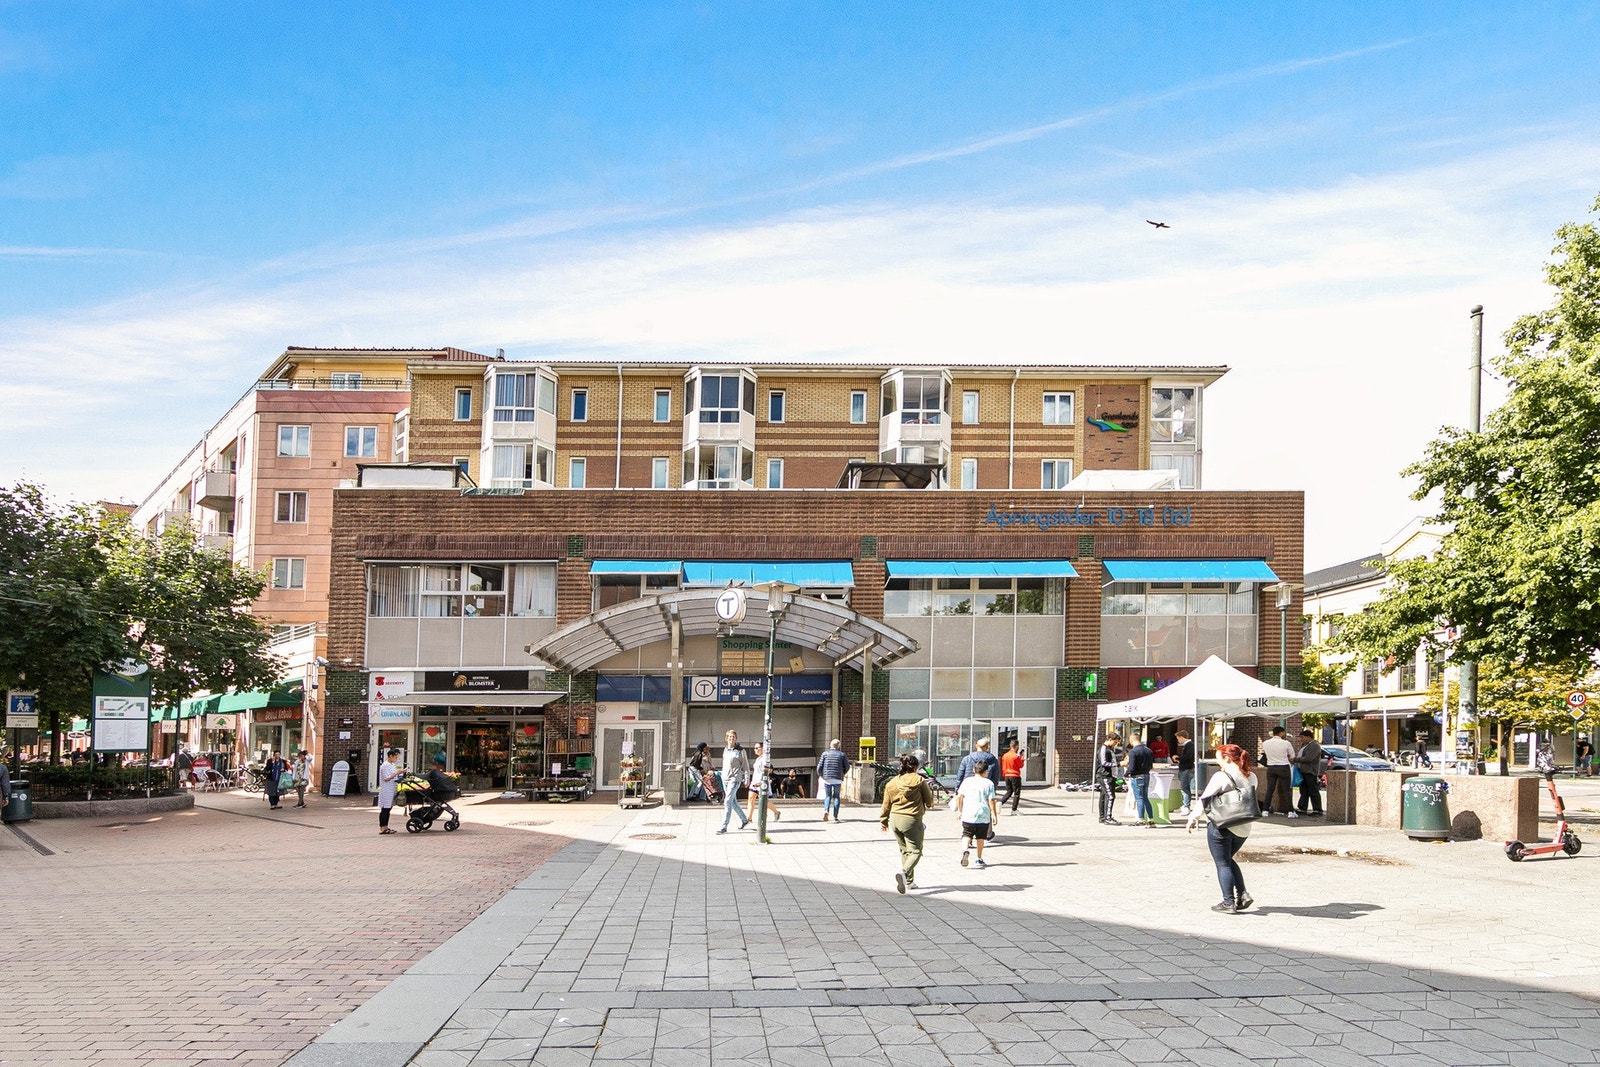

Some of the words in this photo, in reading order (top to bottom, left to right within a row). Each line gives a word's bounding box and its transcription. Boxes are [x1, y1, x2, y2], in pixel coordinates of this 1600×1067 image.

[1107, 507, 1125, 526] 10
[1137, 507, 1156, 526] 18
[1162, 505, 1192, 527] (16)
[722, 597, 735, 615] T
[722, 640, 763, 649] Shopping
[765, 640, 792, 649] Snter
[721, 677, 761, 687] Grønland
[1246, 697, 1299, 708] talkmore
[1571, 694, 1584, 702] 40
